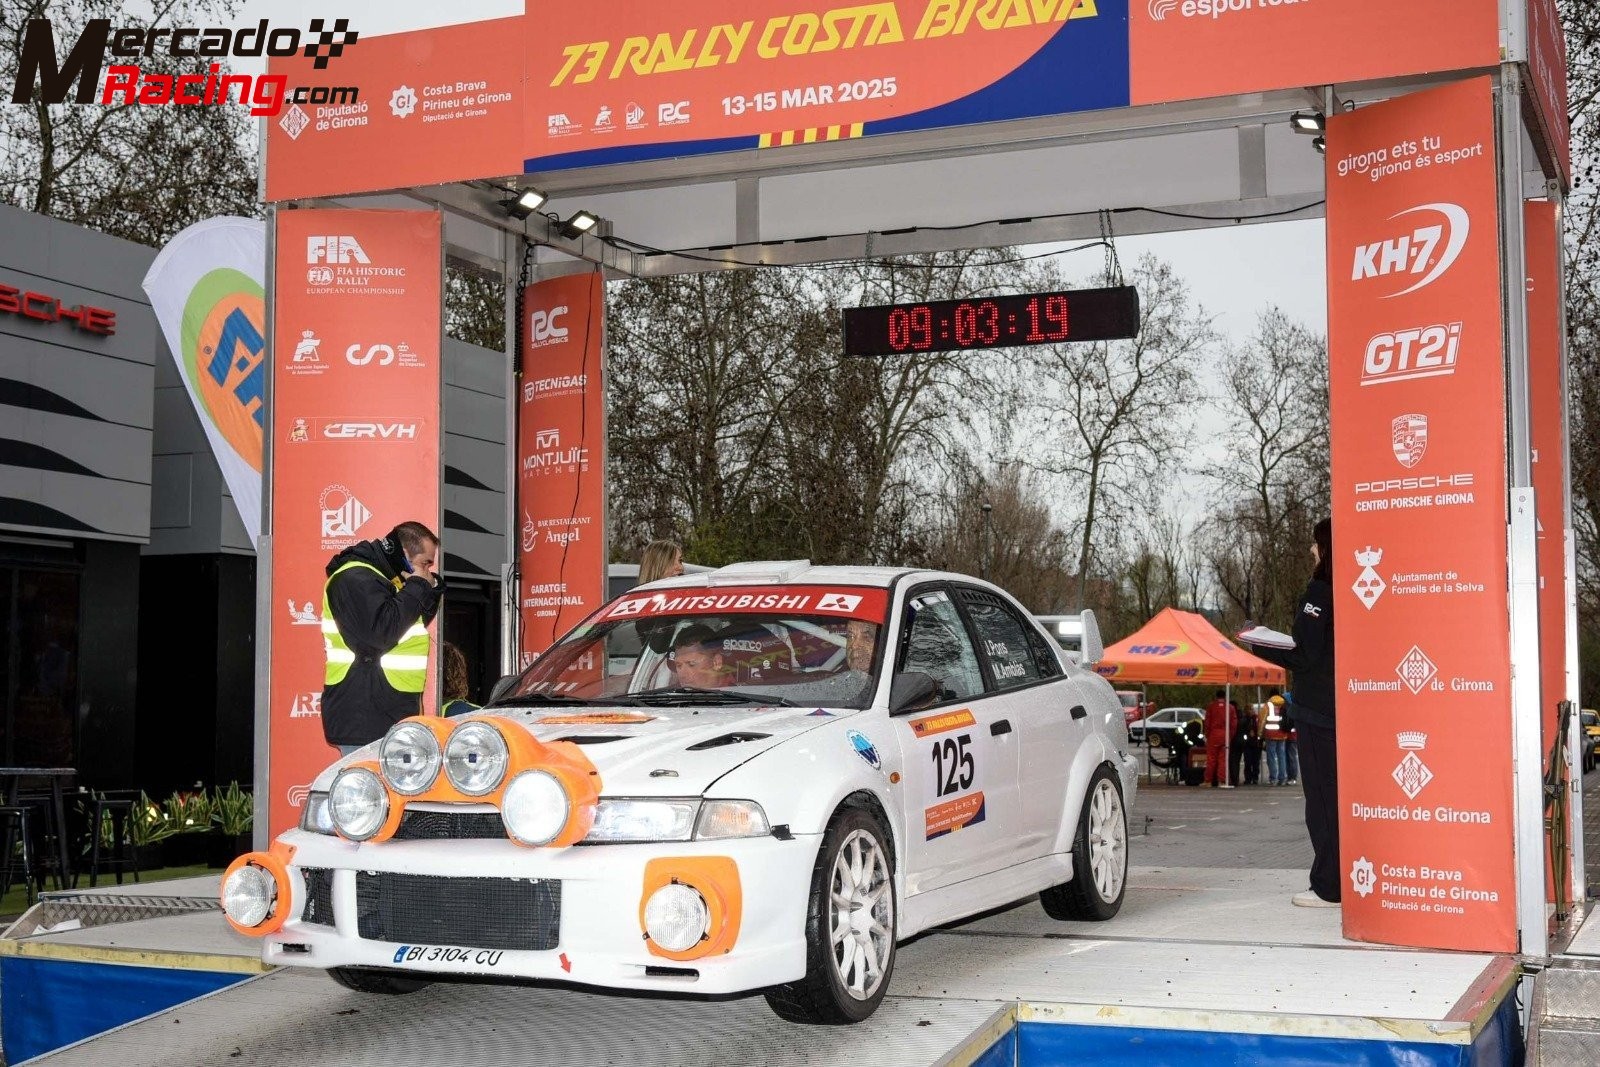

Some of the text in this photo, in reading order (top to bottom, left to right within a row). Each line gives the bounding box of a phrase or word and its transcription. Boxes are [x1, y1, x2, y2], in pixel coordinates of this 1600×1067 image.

[550, 41, 609, 87] 73
[608, 20, 755, 80] RALLY
[757, 1, 904, 59] COSTA
[423, 81, 486, 97] Costa Brava
[721, 76, 897, 116] 13-15 MAR 2025
[423, 91, 512, 111] Pirineu de Girona
[316, 101, 368, 119] Diputació
[423, 112, 454, 123] Diputació
[465, 108, 487, 118] Girona
[316, 115, 369, 132] de Girona
[548, 113, 571, 127] FIA
[1337, 136, 1441, 176] girona ets tu
[1371, 142, 1483, 182] girona és esport
[307, 236, 371, 264] FIA
[337, 267, 406, 276] FIA HISTORIC
[337, 277, 370, 285] RALLY
[1355, 473, 1473, 494] PORSCHE
[1356, 492, 1474, 512] CENTRO PORSCHE GIRONA
[549, 517, 591, 526] RESTAURANT
[1392, 571, 1457, 584] Ajuntament de
[531, 583, 566, 594] GARATGE
[1429, 584, 1441, 593] de
[1444, 583, 1453, 592] la
[1455, 582, 1484, 592] Selva
[524, 596, 584, 607] INTERNACIONAL
[652, 594, 811, 614] MITSUBISHI
[1347, 678, 1493, 693] Ajuntament de Girona
[932, 734, 974, 797] 125
[1352, 802, 1491, 824] Diputació de Girona
[1381, 864, 1462, 881] Costa Brava
[1381, 882, 1499, 902] Pirineu de Girona
[1381, 899, 1464, 914] Diputació de Girona
[406, 946, 503, 966] BI 3104 CU
